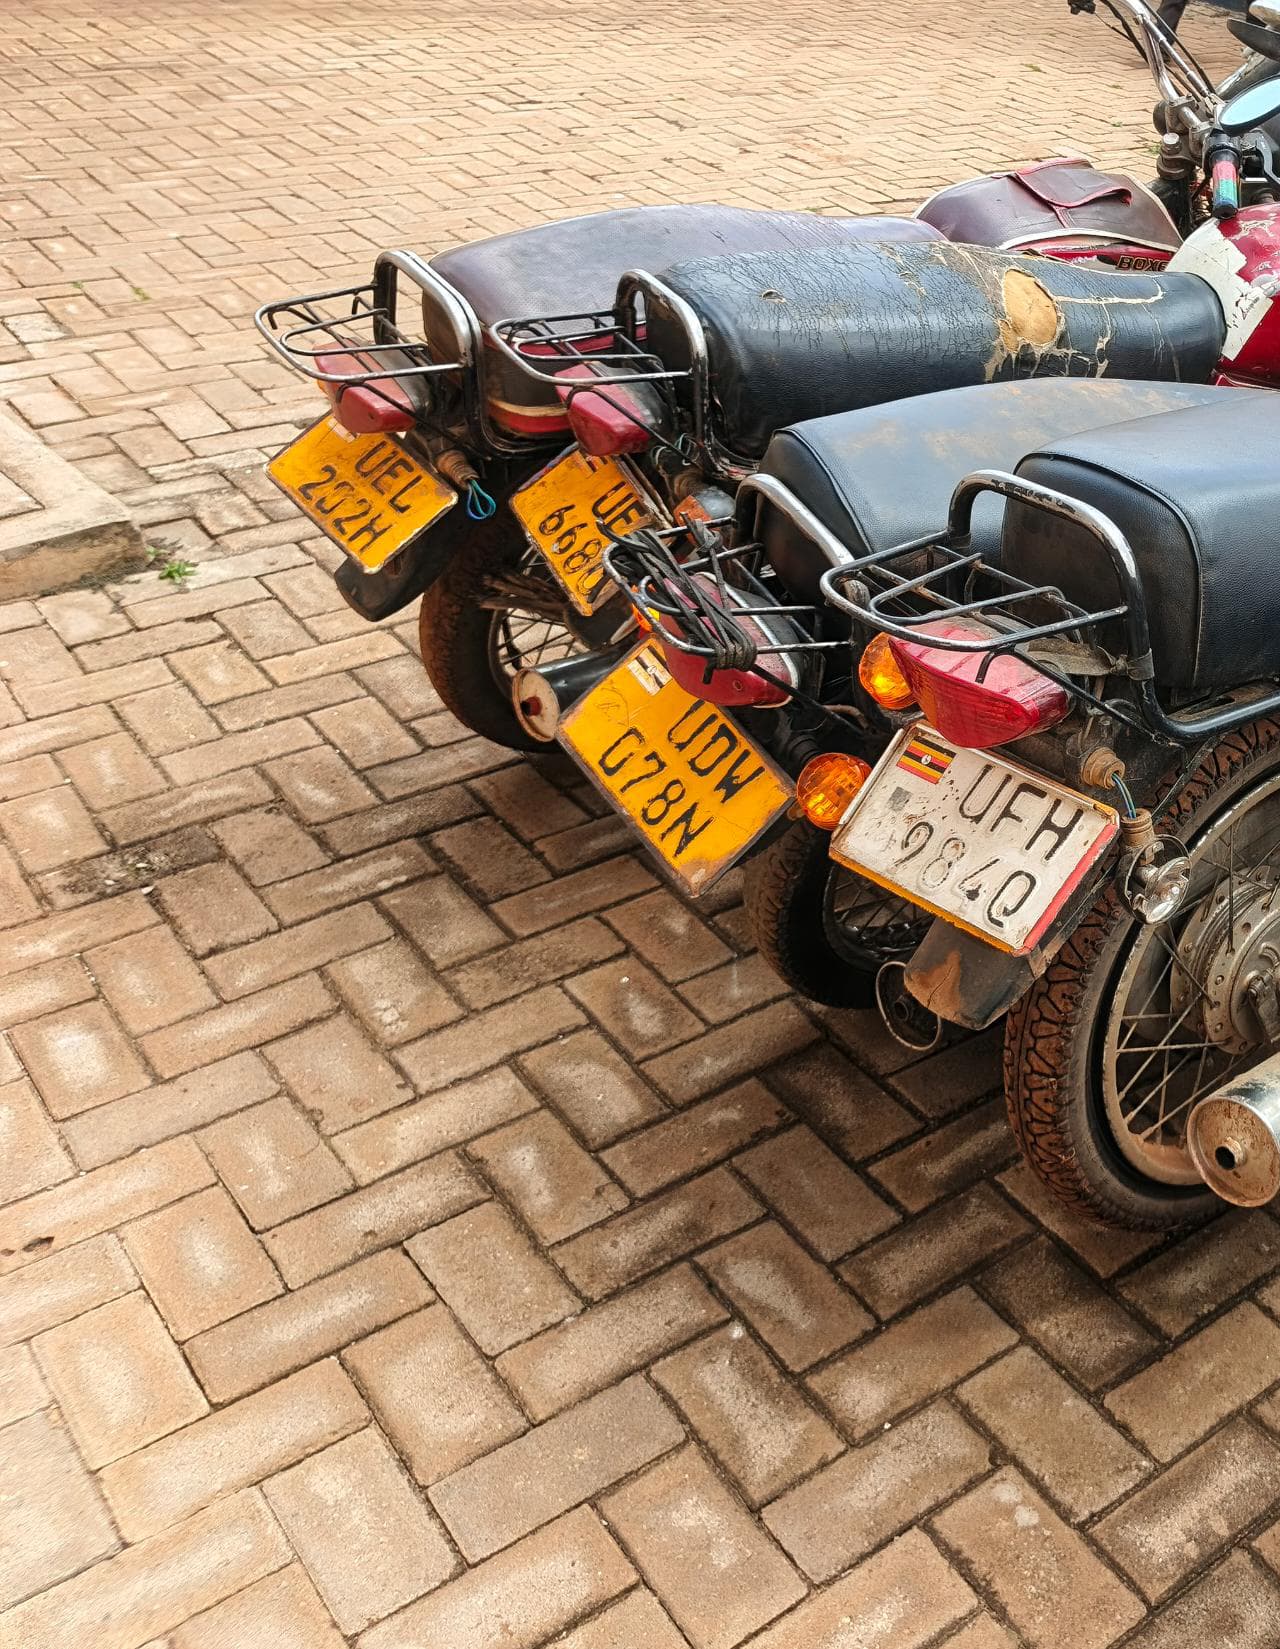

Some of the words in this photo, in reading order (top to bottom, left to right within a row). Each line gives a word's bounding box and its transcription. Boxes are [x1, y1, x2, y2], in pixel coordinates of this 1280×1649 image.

[1116, 255, 1170, 272] BOXE
[297, 464, 393, 555] 202H
[355, 440, 422, 514] UEL
[591, 480, 648, 536] UE
[667, 699, 766, 804] UDW
[958, 763, 1084, 862] UFH
